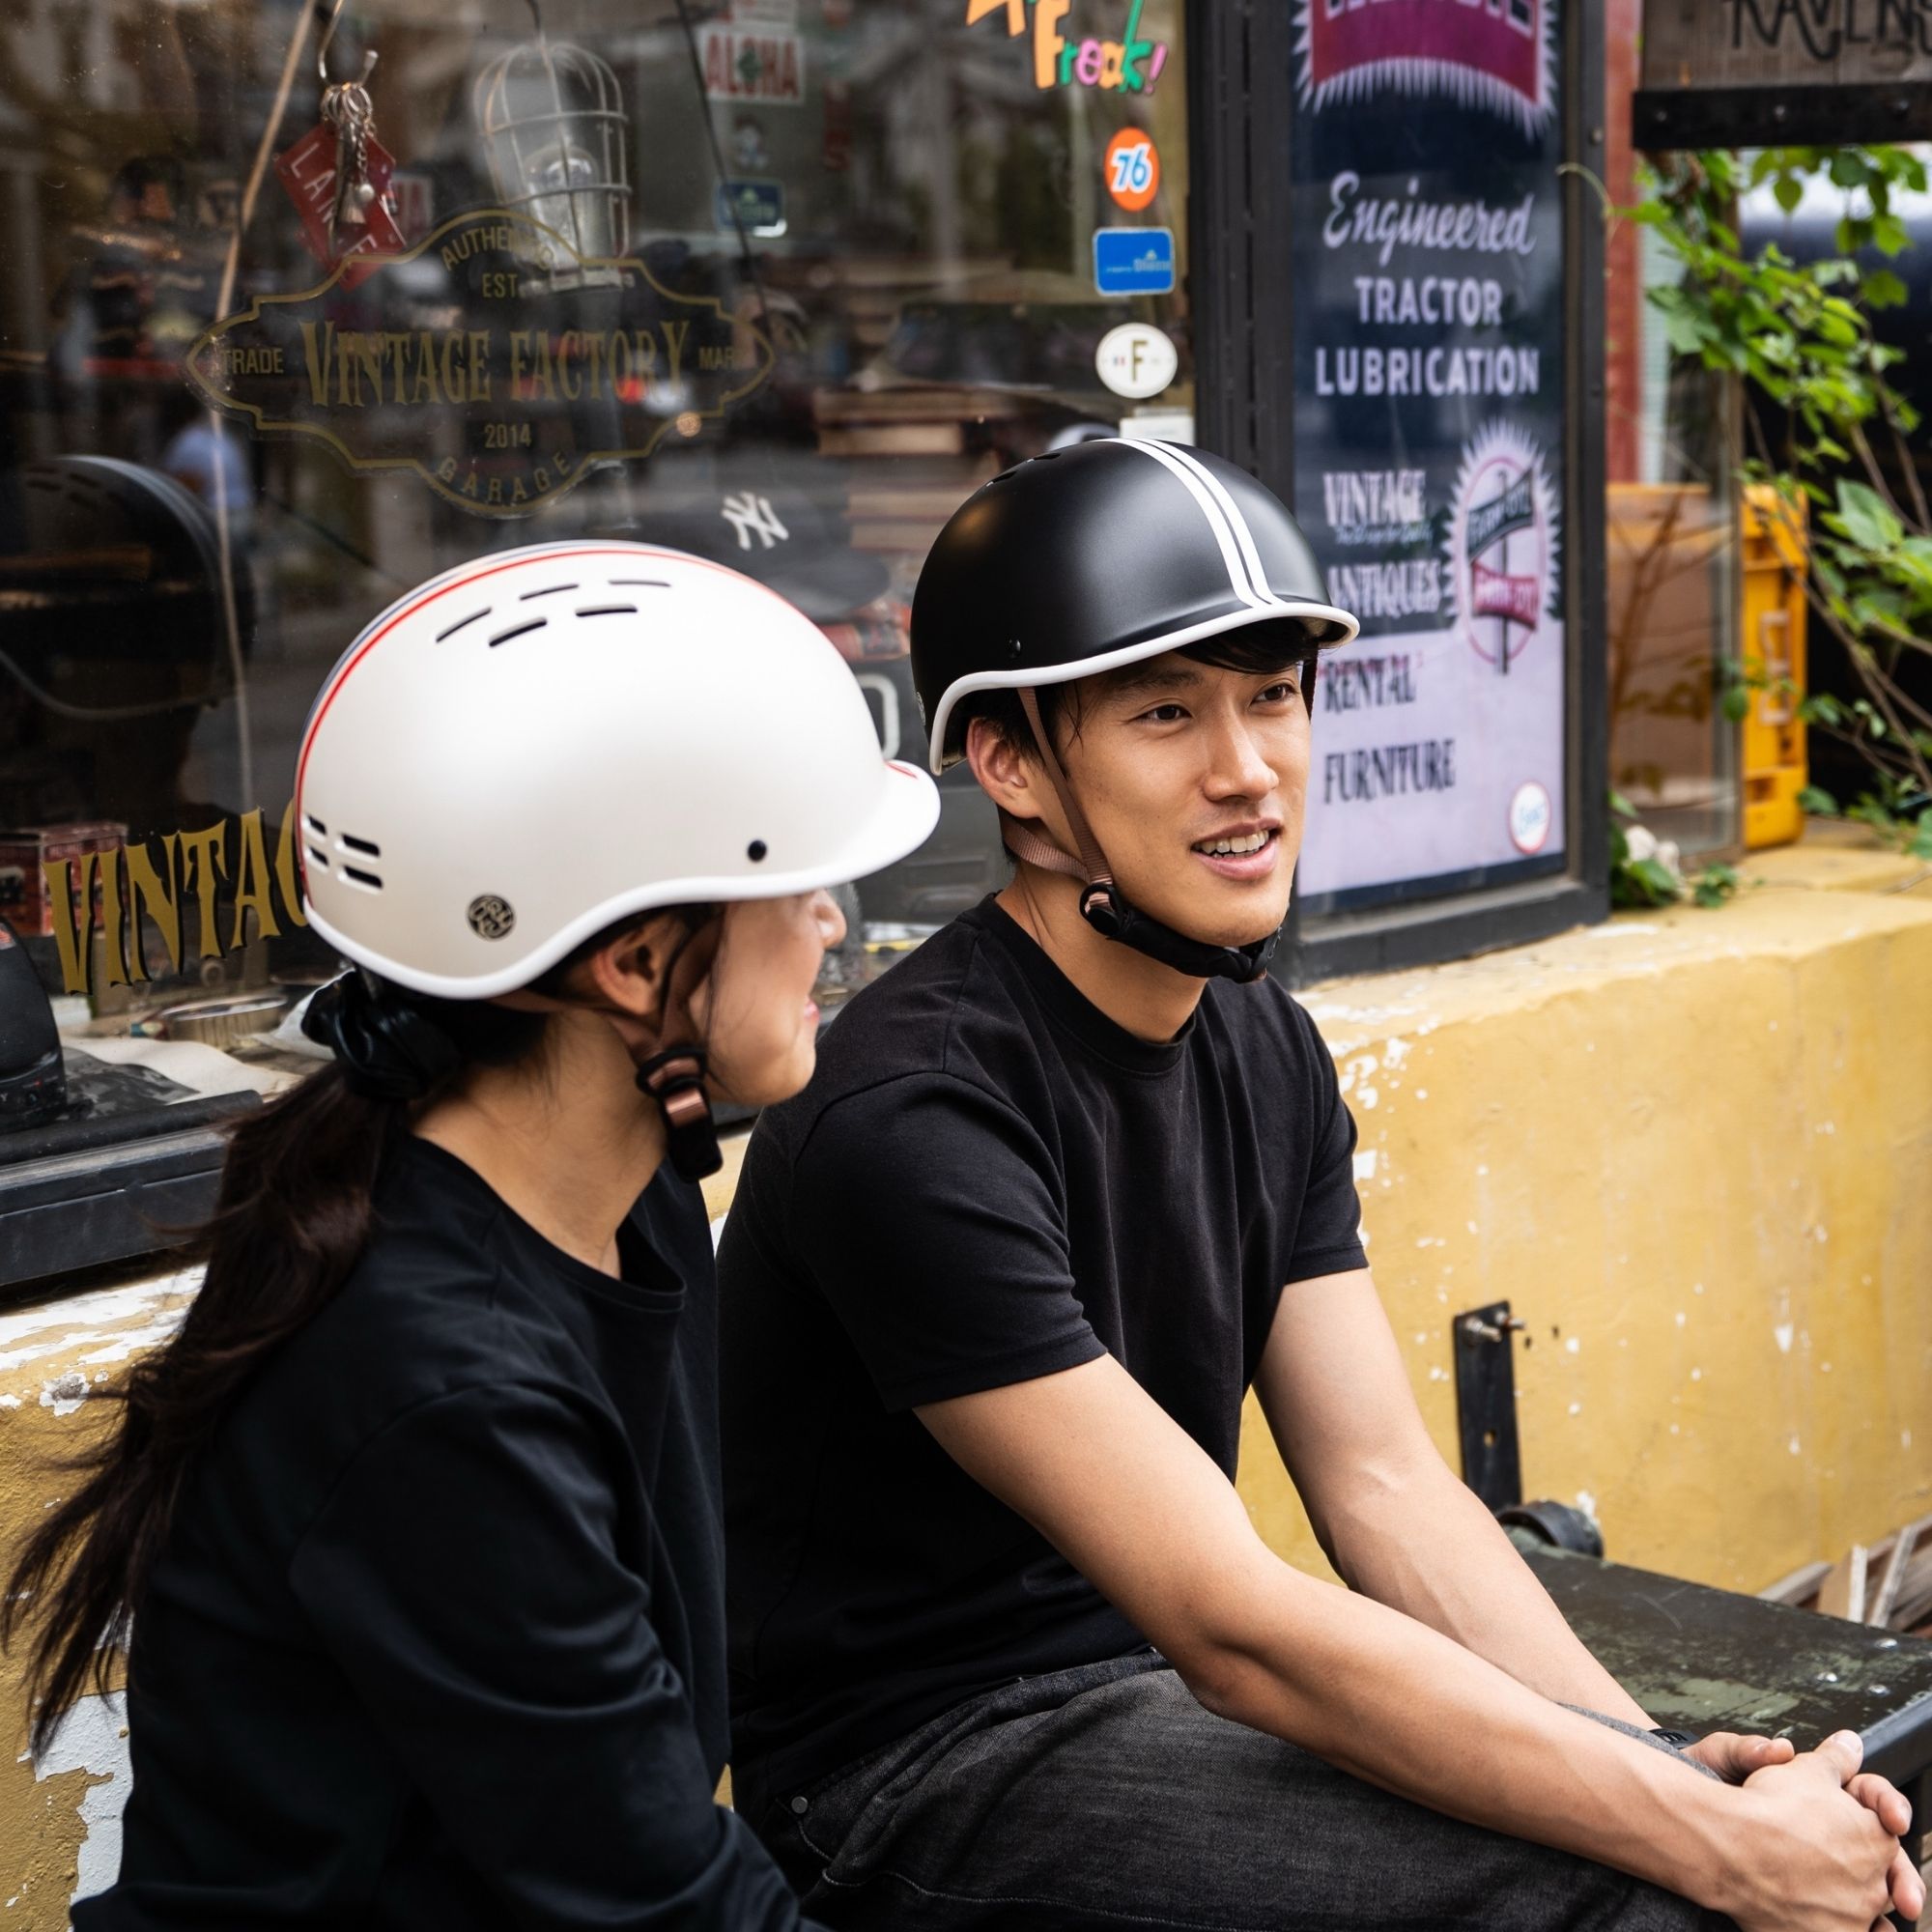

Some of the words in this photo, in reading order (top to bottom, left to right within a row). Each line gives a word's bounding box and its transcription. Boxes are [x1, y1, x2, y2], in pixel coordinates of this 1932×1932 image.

[1033, 0, 1168, 95] Freak!
[1112, 144, 1153, 193] 76
[1322, 170, 1538, 268] Engineered
[440, 225, 554, 271] AUTHEC
[1354, 276, 1503, 327] TRACTOR
[219, 348, 284, 374] TRADE
[298, 320, 492, 408] VINTAGE
[509, 320, 691, 403] FACTORY
[698, 346, 744, 371] MAR
[1131, 339, 1149, 384] F
[1316, 346, 1541, 397] LUBRICATION
[485, 422, 533, 449] 2014
[437, 450, 572, 503] GARAGE
[1323, 468, 1427, 527] VINTAGE
[1327, 557, 1442, 619] ANTIQUES
[1324, 654, 1417, 715] RENTAL
[1323, 737, 1456, 806] FURNITURE
